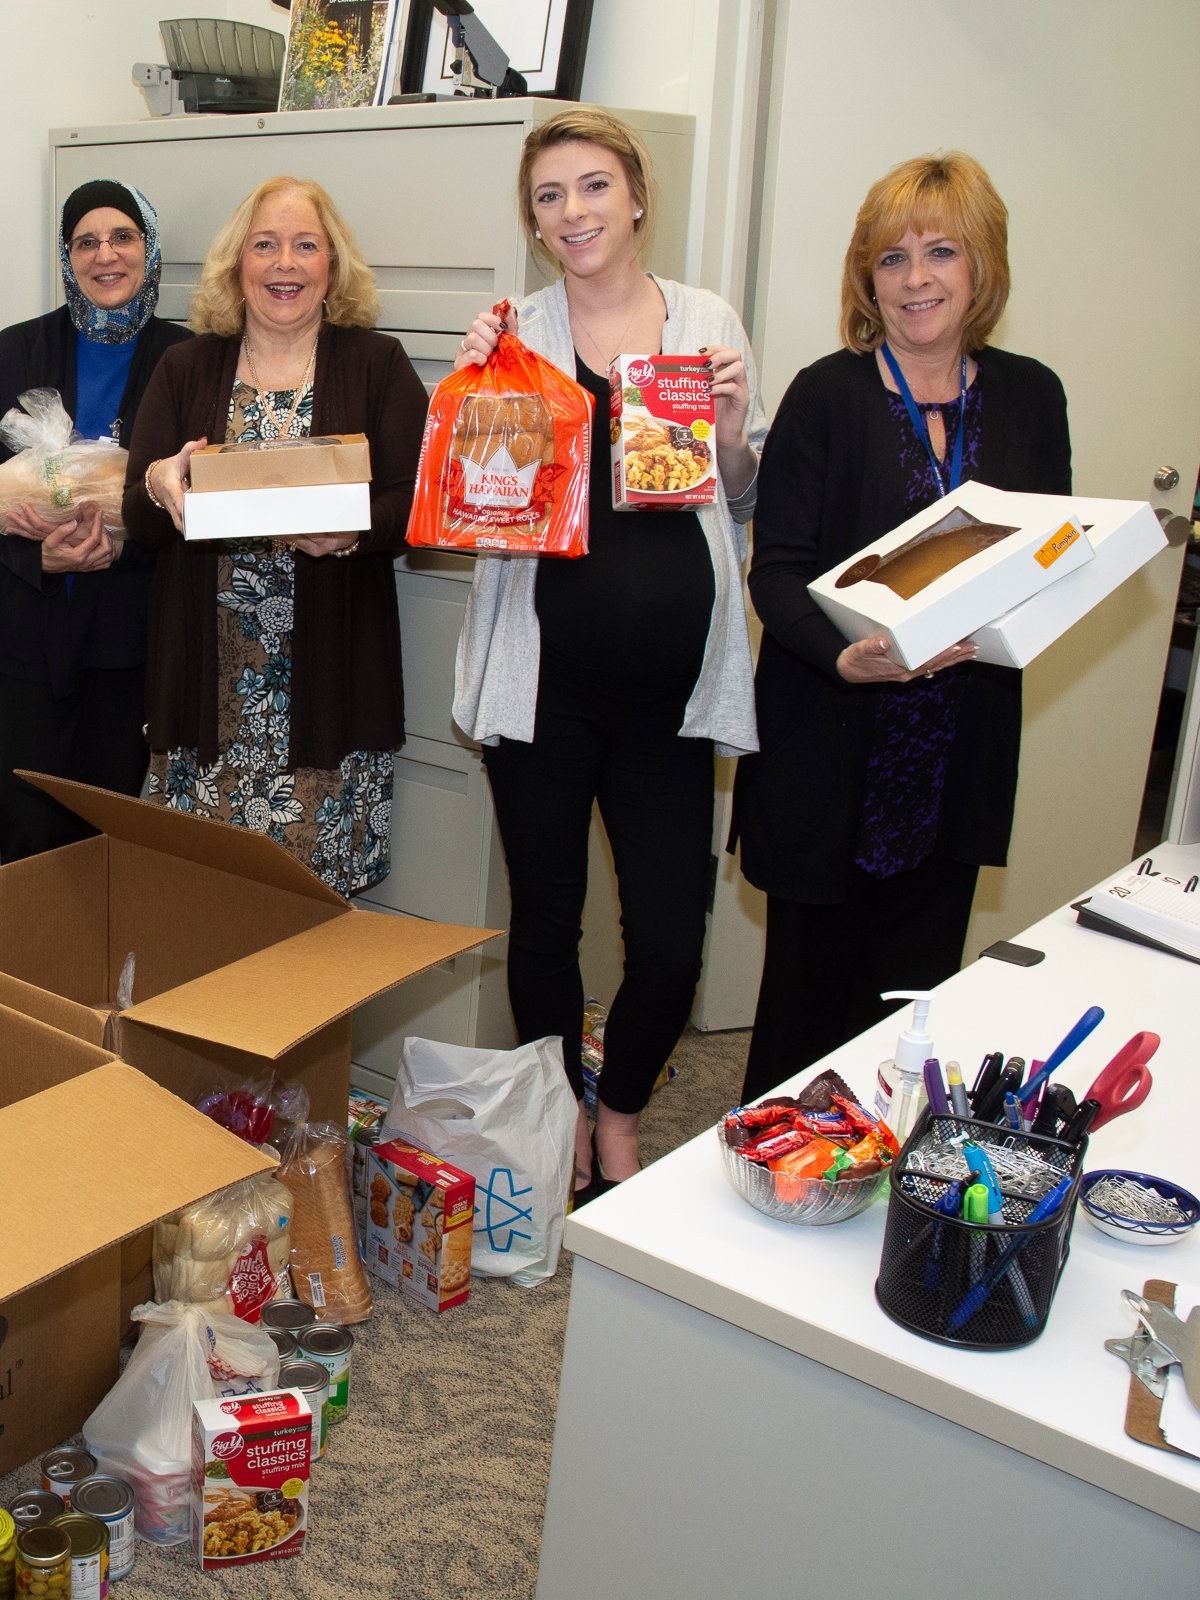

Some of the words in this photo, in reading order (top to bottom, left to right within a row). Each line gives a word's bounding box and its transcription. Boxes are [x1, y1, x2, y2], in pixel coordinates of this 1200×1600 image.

[658, 377, 709, 392] stuffing
[659, 389, 710, 402] classics
[672, 403, 698, 411] stuffing
[481, 473, 518, 486] KING'S
[469, 484, 529, 497] HAWAIIAN
[452, 508, 488, 522] HAWAIIAN
[490, 516, 515, 524] SWEET
[516, 511, 540, 523] ROLLS
[438, 537, 447, 546] 16
[1051, 529, 1077, 552] Pumpkin
[452, 1200, 468, 1210] TOWN
[252, 1401, 284, 1411] stuffing
[255, 1405, 287, 1415] classics
[273, 1428, 297, 1437] turkey
[246, 1438, 307, 1458] stuffing
[247, 1451, 306, 1470] classics
[261, 1464, 290, 1475] stuffing
